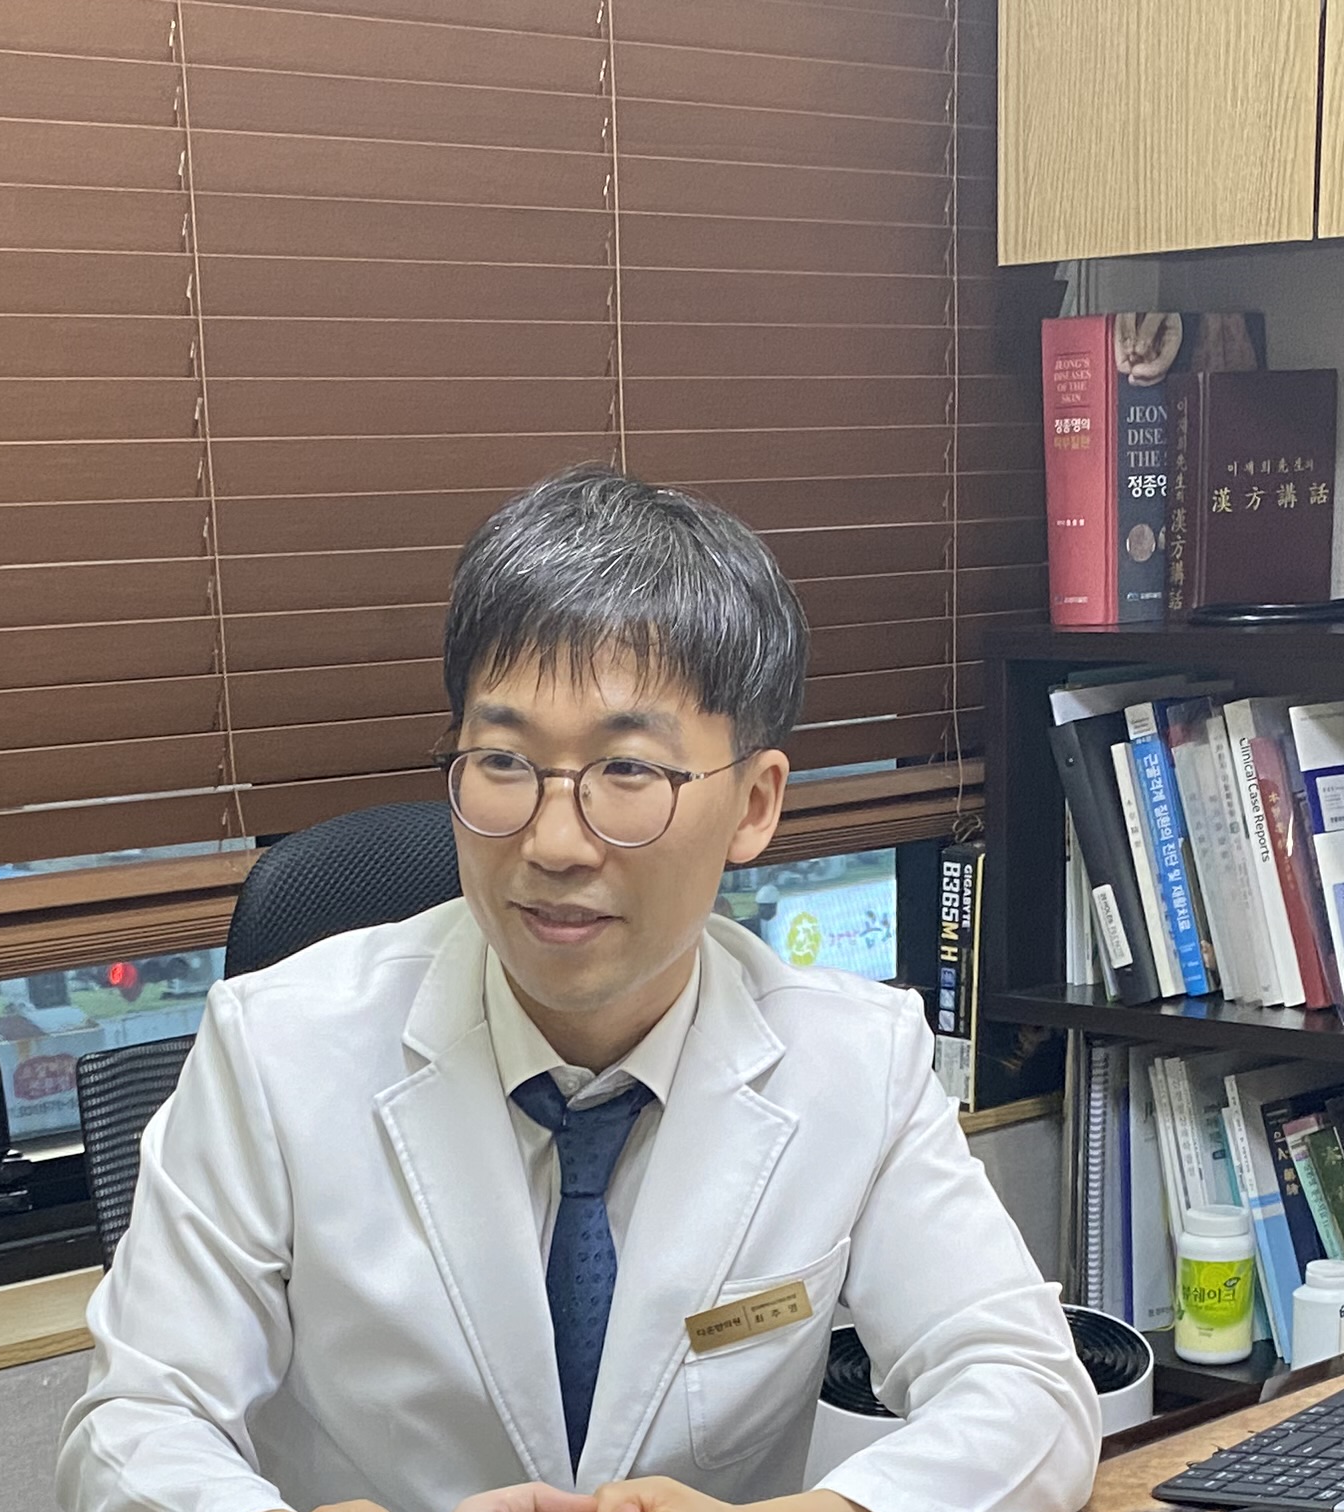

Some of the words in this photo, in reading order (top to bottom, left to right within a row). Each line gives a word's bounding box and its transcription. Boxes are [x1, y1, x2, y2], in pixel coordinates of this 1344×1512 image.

[1054, 418, 1091, 434] 정종영의
[1211, 481, 1330, 513] 漢方講話
[1239, 737, 1254, 778] Clinical
[1248, 781, 1260, 812] Case
[1254, 815, 1271, 863] Reports
[940, 861, 961, 940] B365M
[961, 864, 973, 929] GIGABYTE
[940, 946, 958, 963] H
